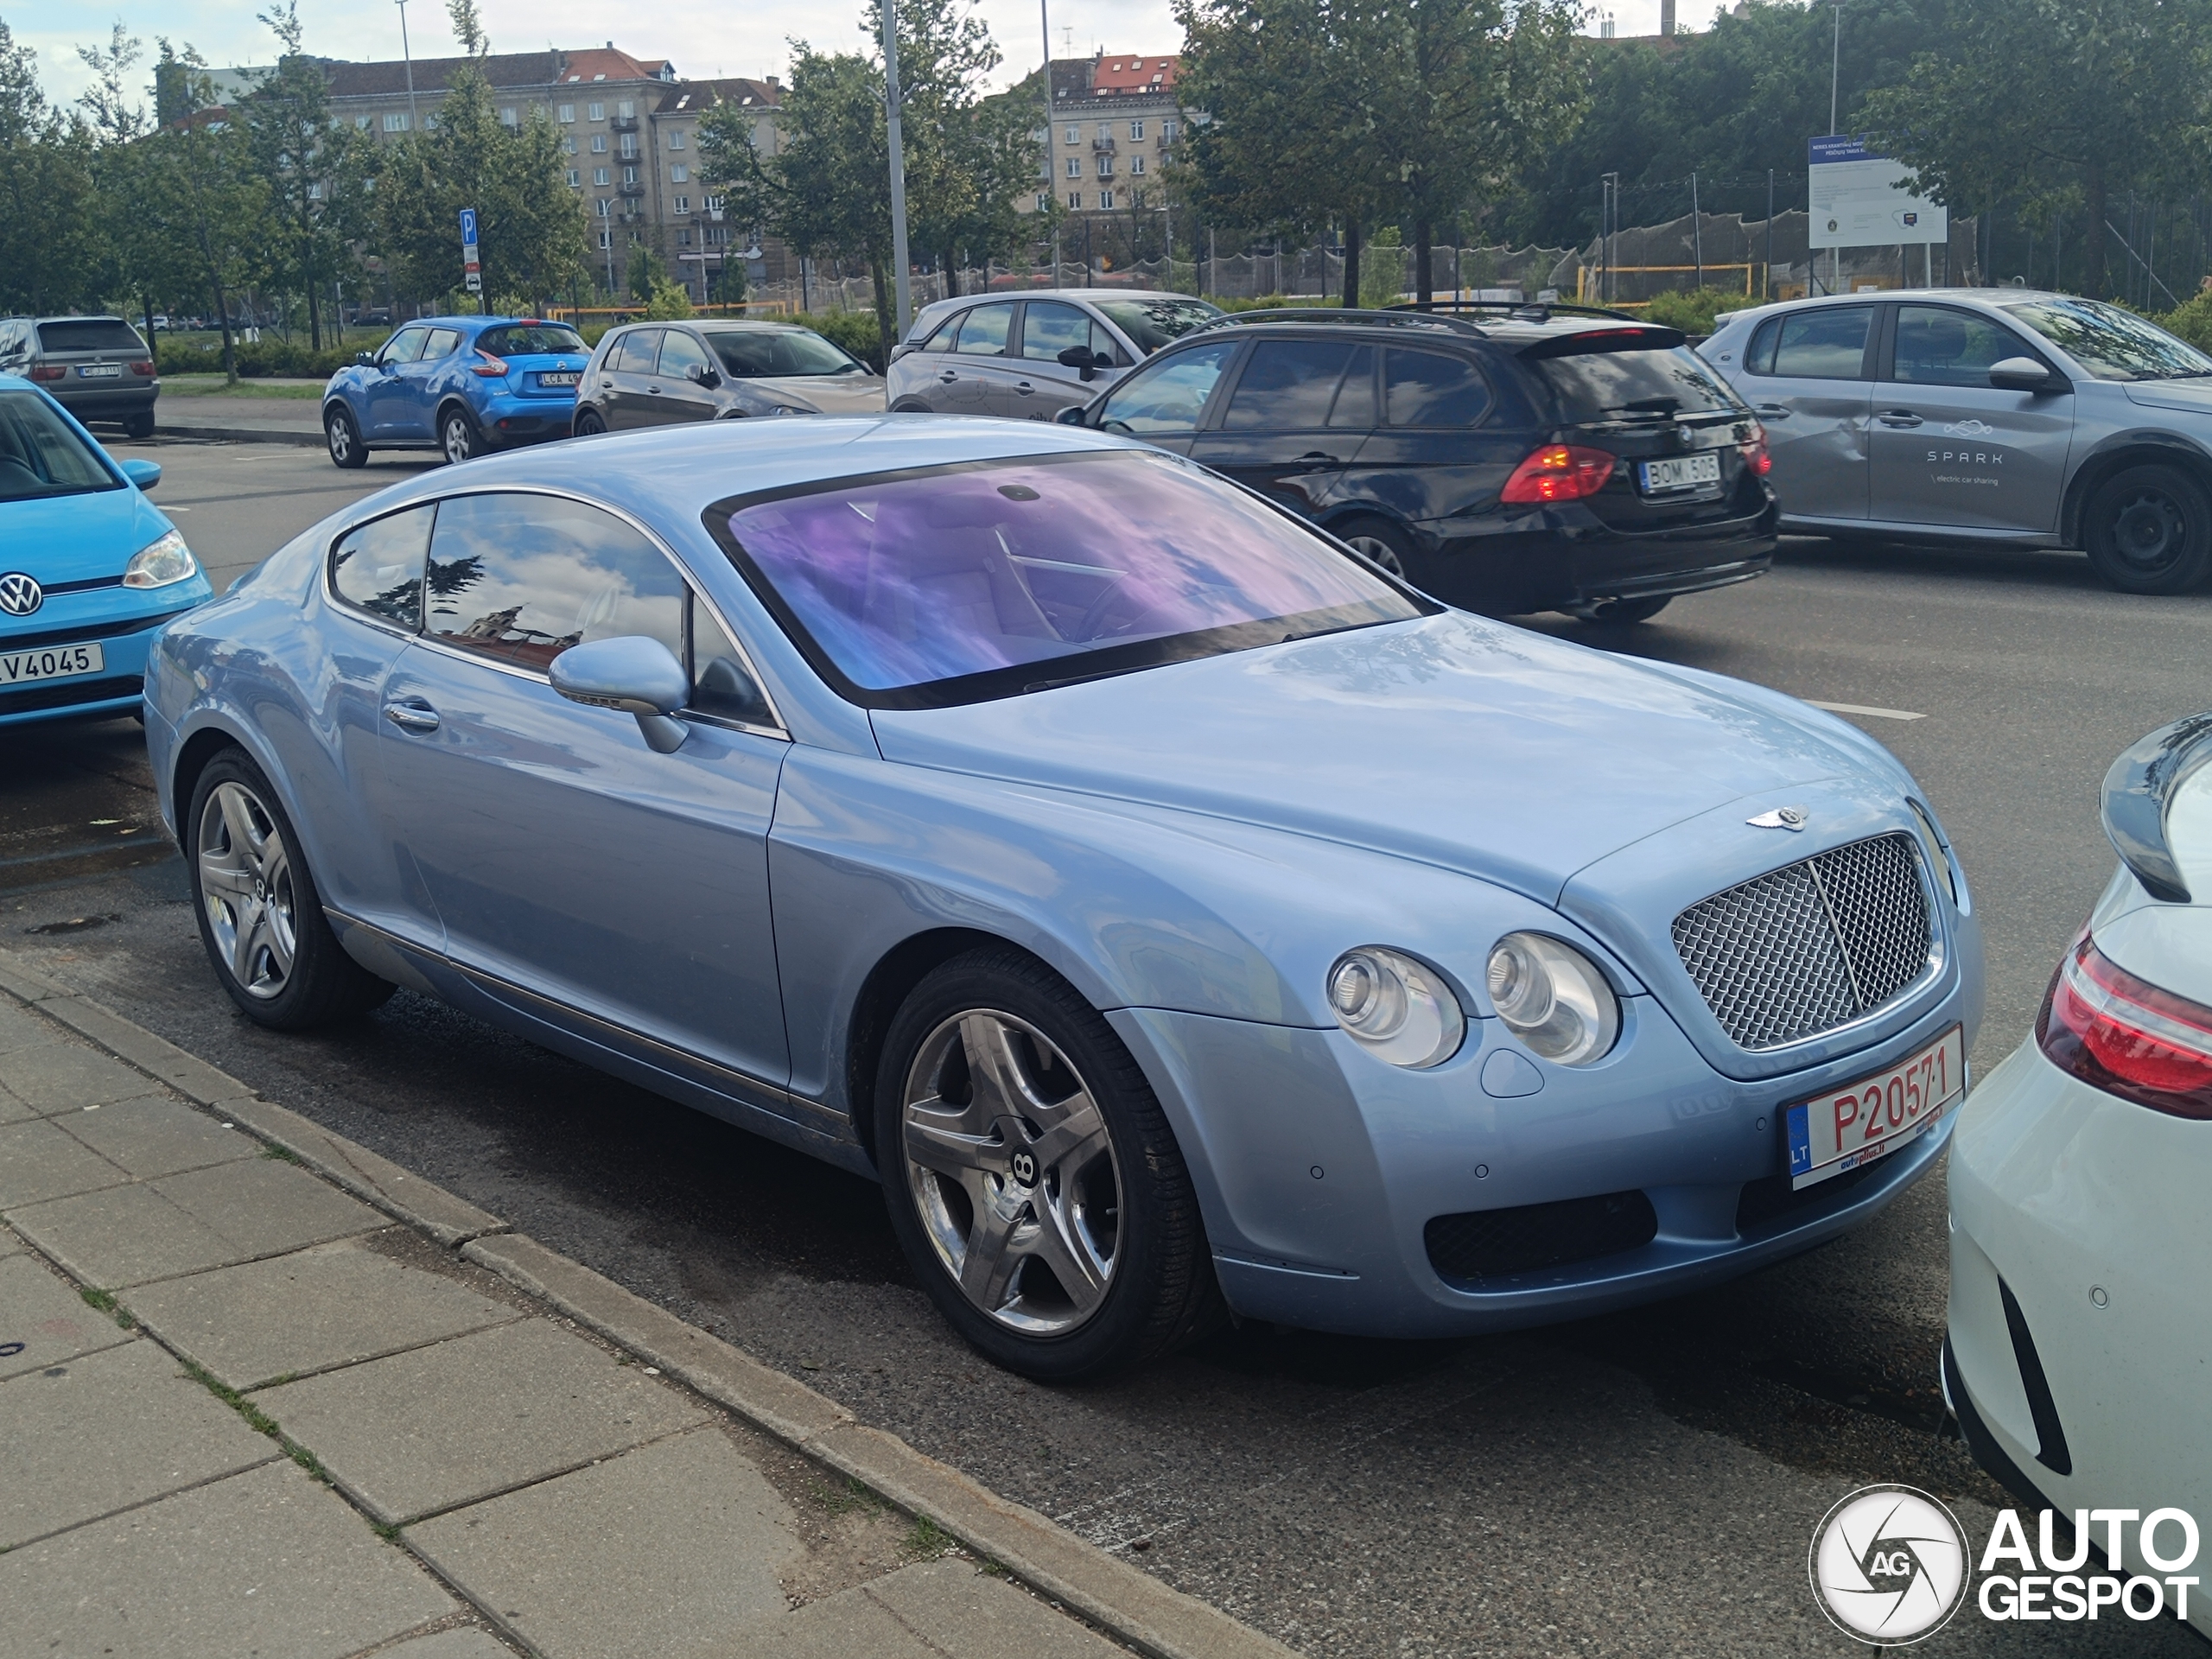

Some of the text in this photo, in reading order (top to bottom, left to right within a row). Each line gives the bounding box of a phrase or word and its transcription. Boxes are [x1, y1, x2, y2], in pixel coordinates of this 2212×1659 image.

[464, 213, 474, 242] P
[543, 374, 563, 383] LCA
[1927, 451, 2003, 464] SPARK
[1974, 477, 1999, 486] sharing
[0, 648, 90, 681] V4045
[1834, 1046, 1947, 1152] P20571
[1791, 1145, 1808, 1165] LT
[1840, 1144, 1885, 1170] autoplius.lt
